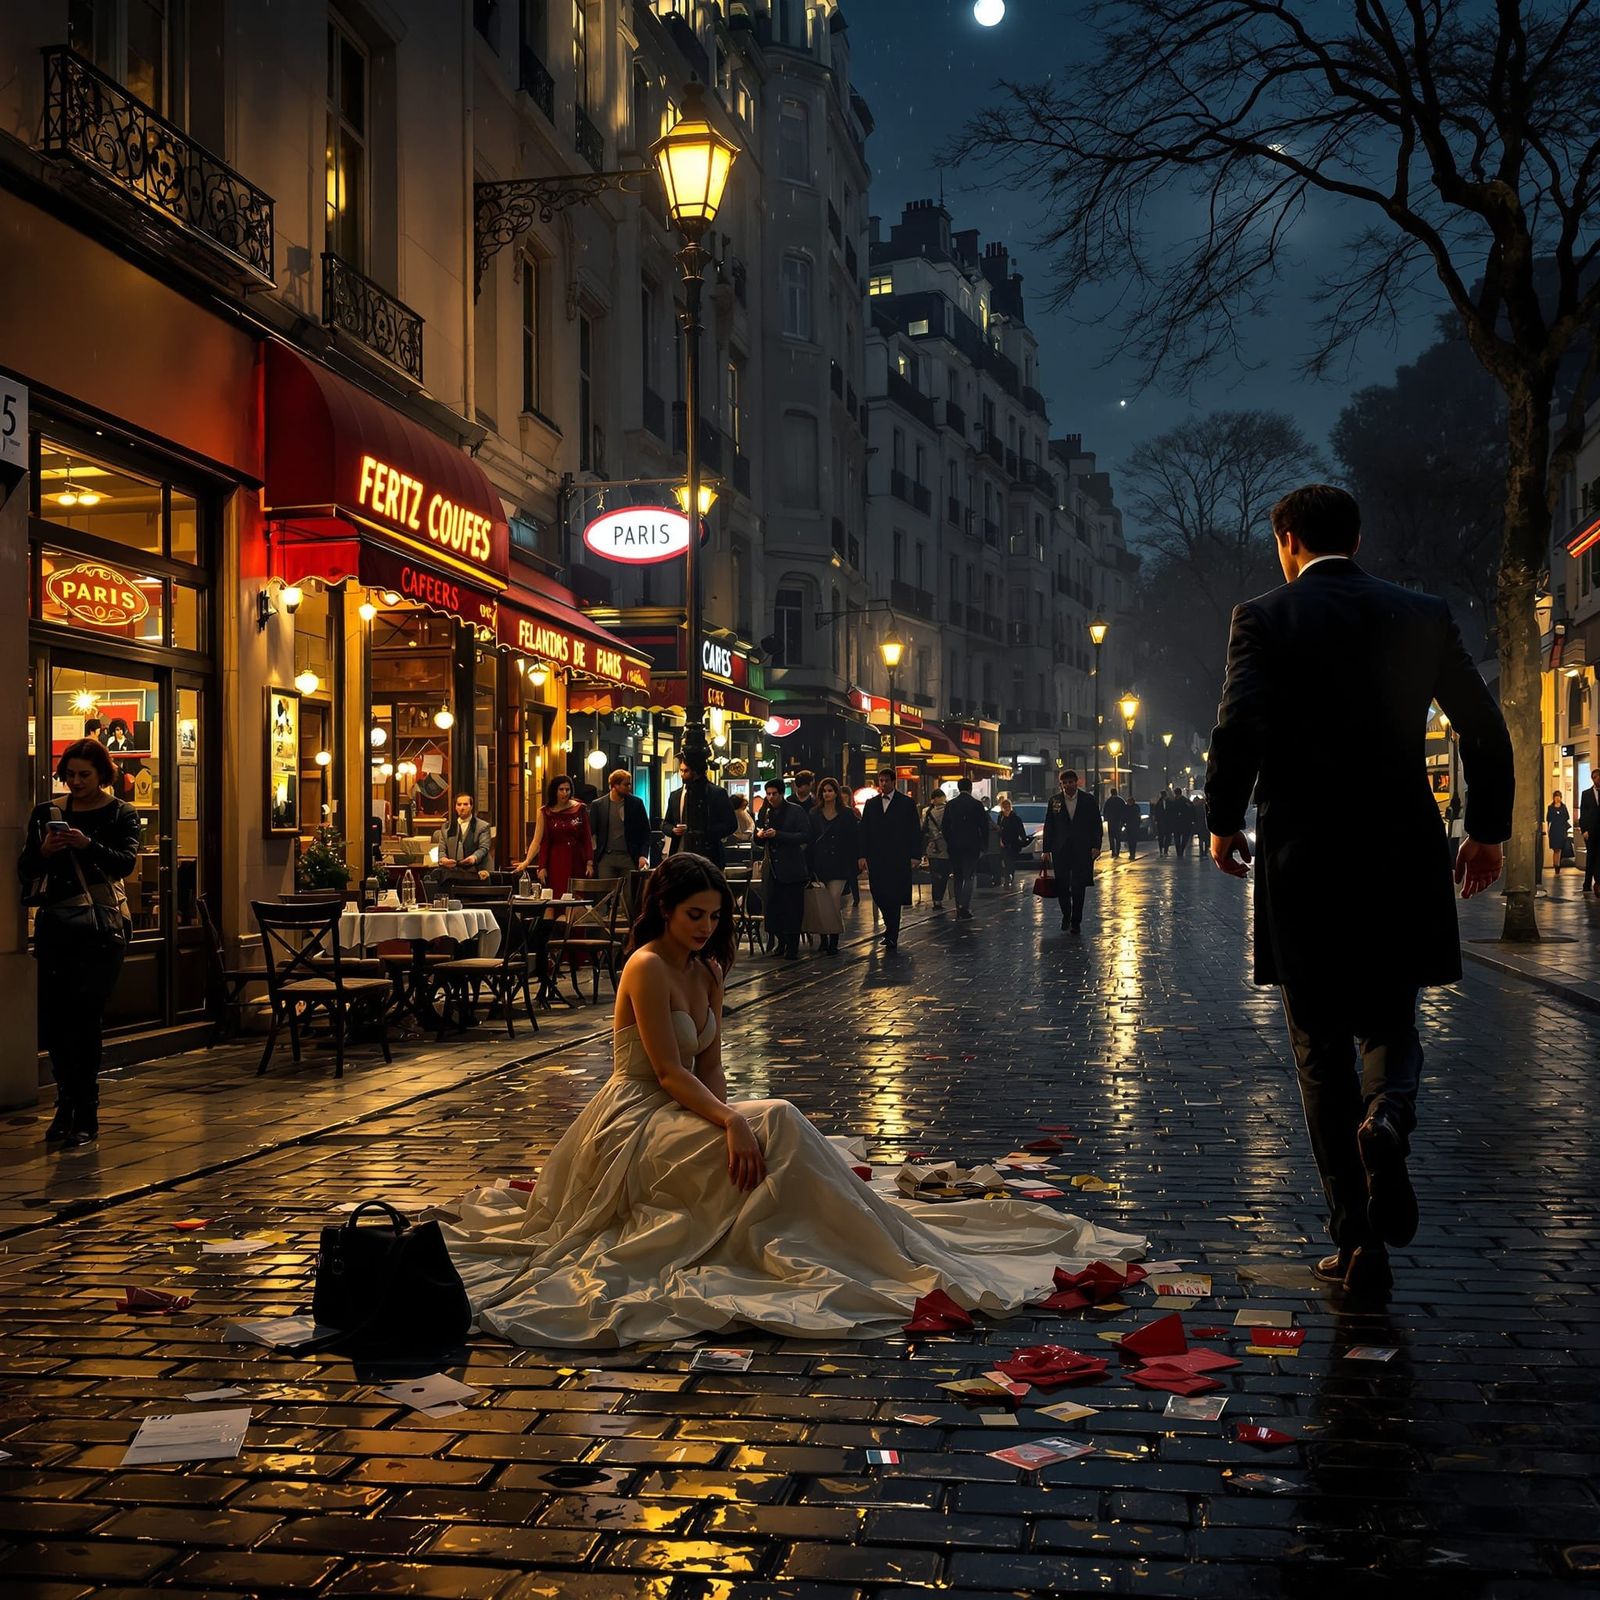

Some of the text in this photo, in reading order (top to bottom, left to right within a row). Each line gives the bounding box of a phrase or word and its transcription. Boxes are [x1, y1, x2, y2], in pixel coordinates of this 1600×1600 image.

[359, 455, 492, 561] FERTZ COUFES
[614, 524, 670, 545] PARIS
[61, 581, 136, 609] PARIS
[401, 567, 460, 611] CAFEERS
[573, 640, 586, 668] DE
